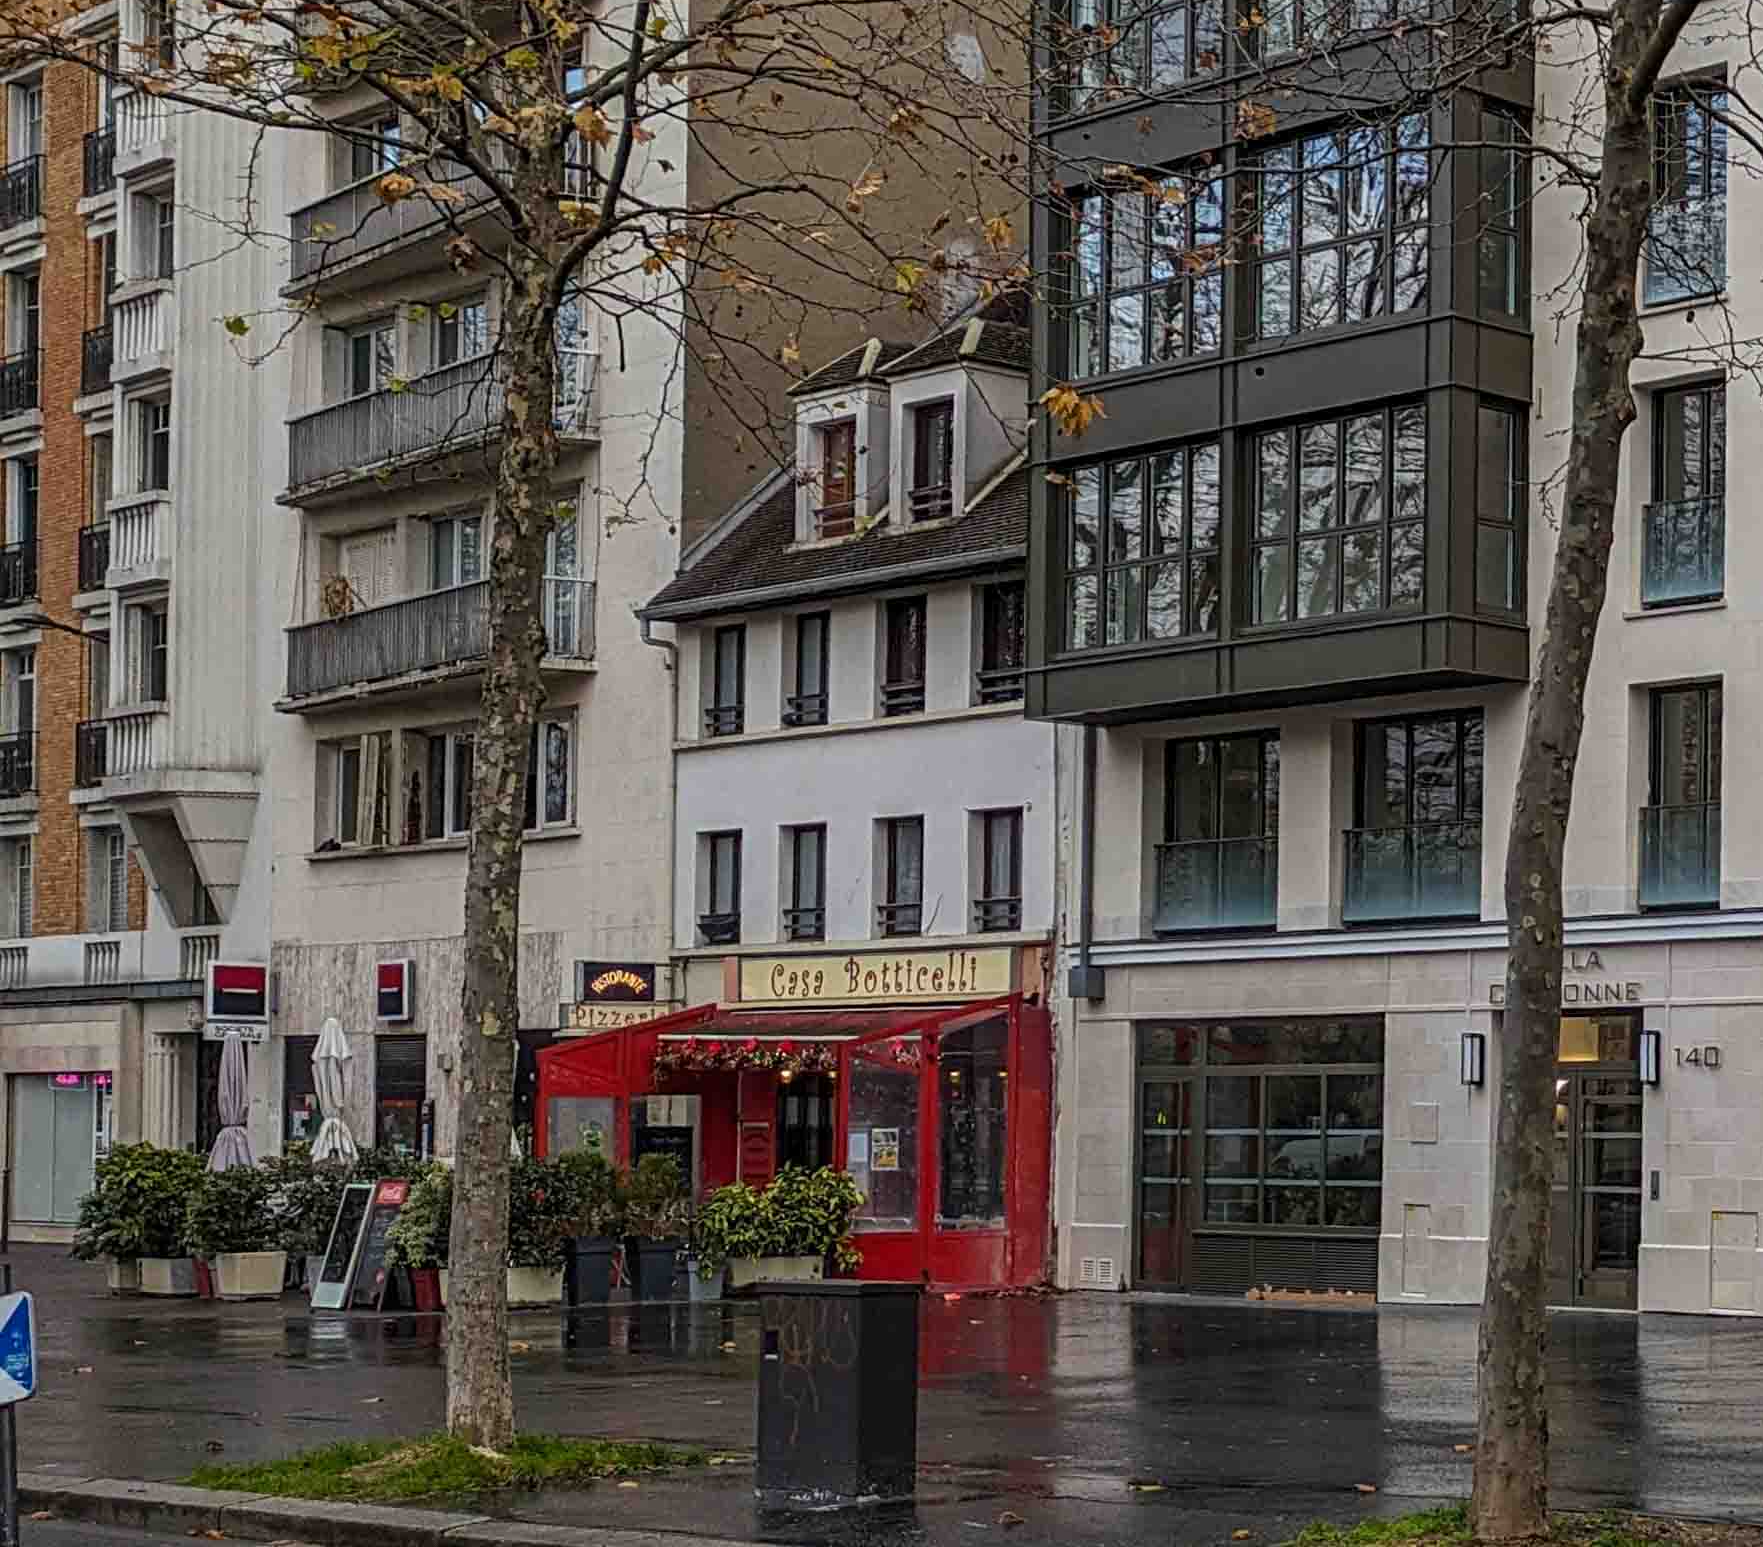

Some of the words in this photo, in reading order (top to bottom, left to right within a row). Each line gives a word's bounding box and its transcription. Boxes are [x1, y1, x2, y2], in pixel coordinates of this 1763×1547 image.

[770, 963, 824, 997] Casa
[844, 951, 977, 994] Botticelli
[576, 1004, 656, 1028] Pizzeri
[1673, 1046, 1722, 1069] 140
